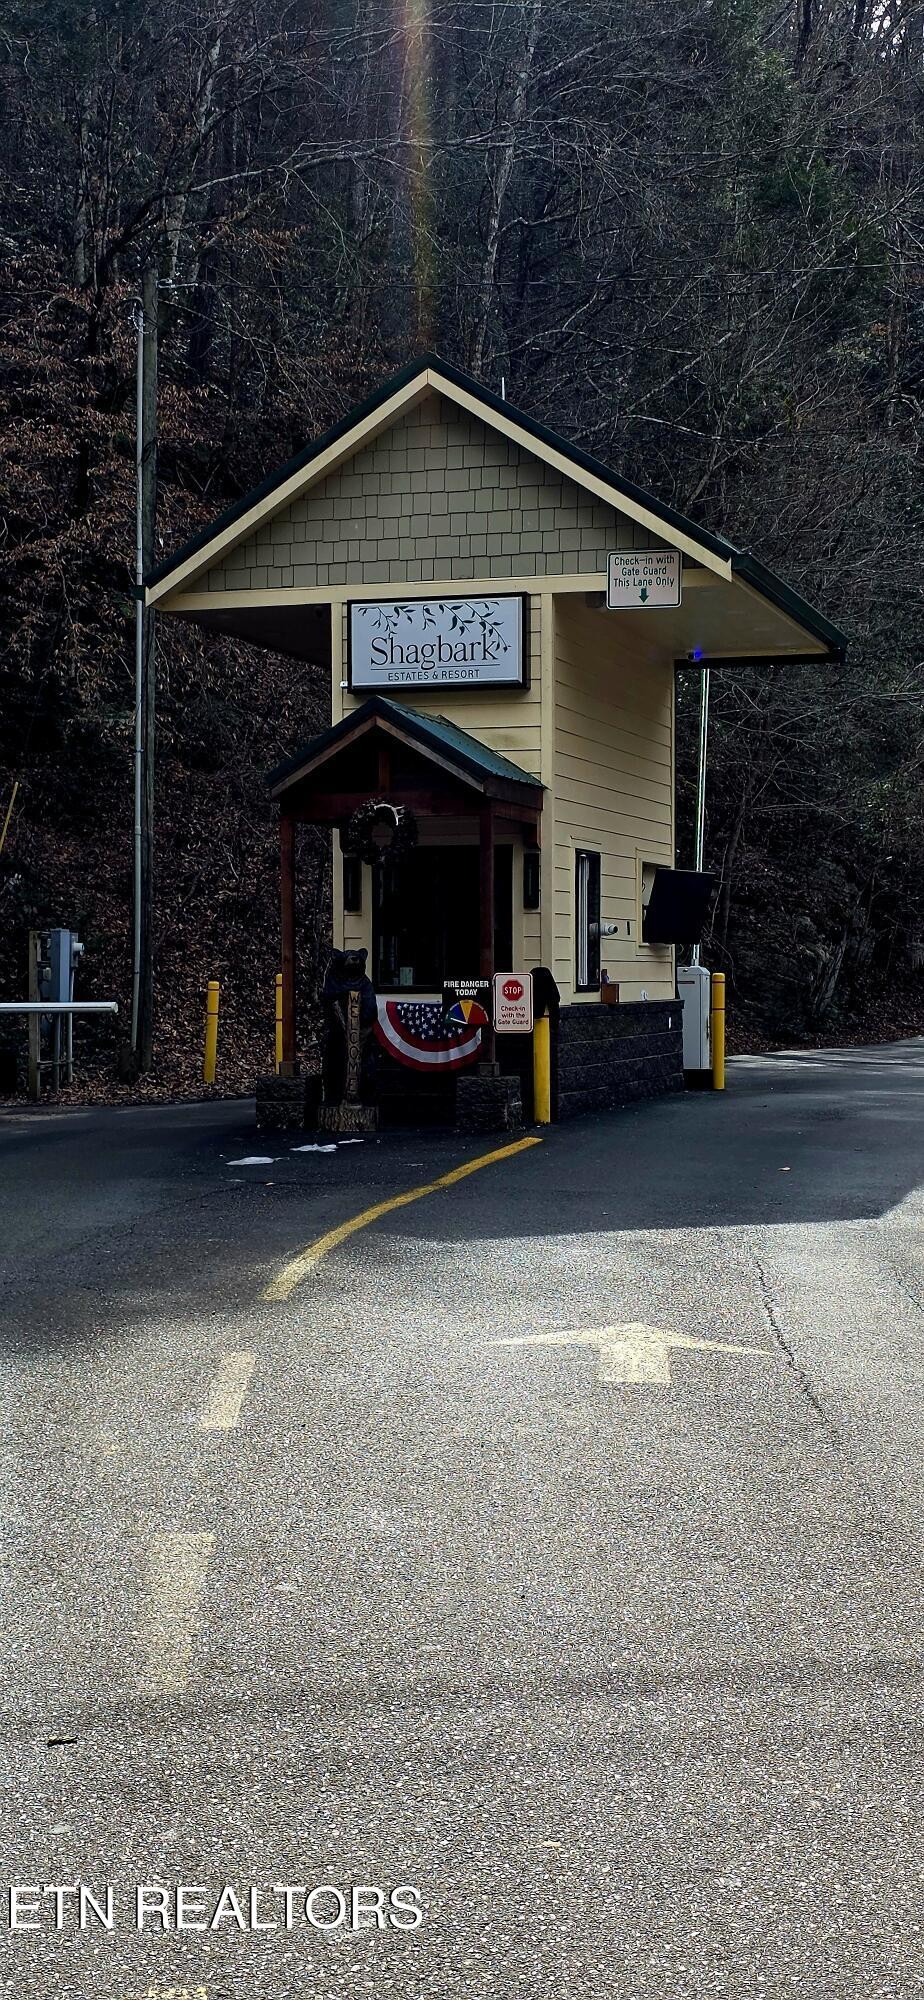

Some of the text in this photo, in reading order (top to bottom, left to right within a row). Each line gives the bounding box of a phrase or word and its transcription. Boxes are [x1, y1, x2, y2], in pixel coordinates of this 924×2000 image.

[614, 555, 675, 566] Check-in with
[621, 566, 667, 576] Gate Guard
[613, 576, 675, 588] This Lane Only
[370, 632, 498, 671] Shagbark
[388, 669, 480, 682] ESTATES & RESORT
[443, 980, 490, 988] FIRE DANGER
[504, 986, 522, 994] STOP
[349, 992, 361, 1092] WELCOME
